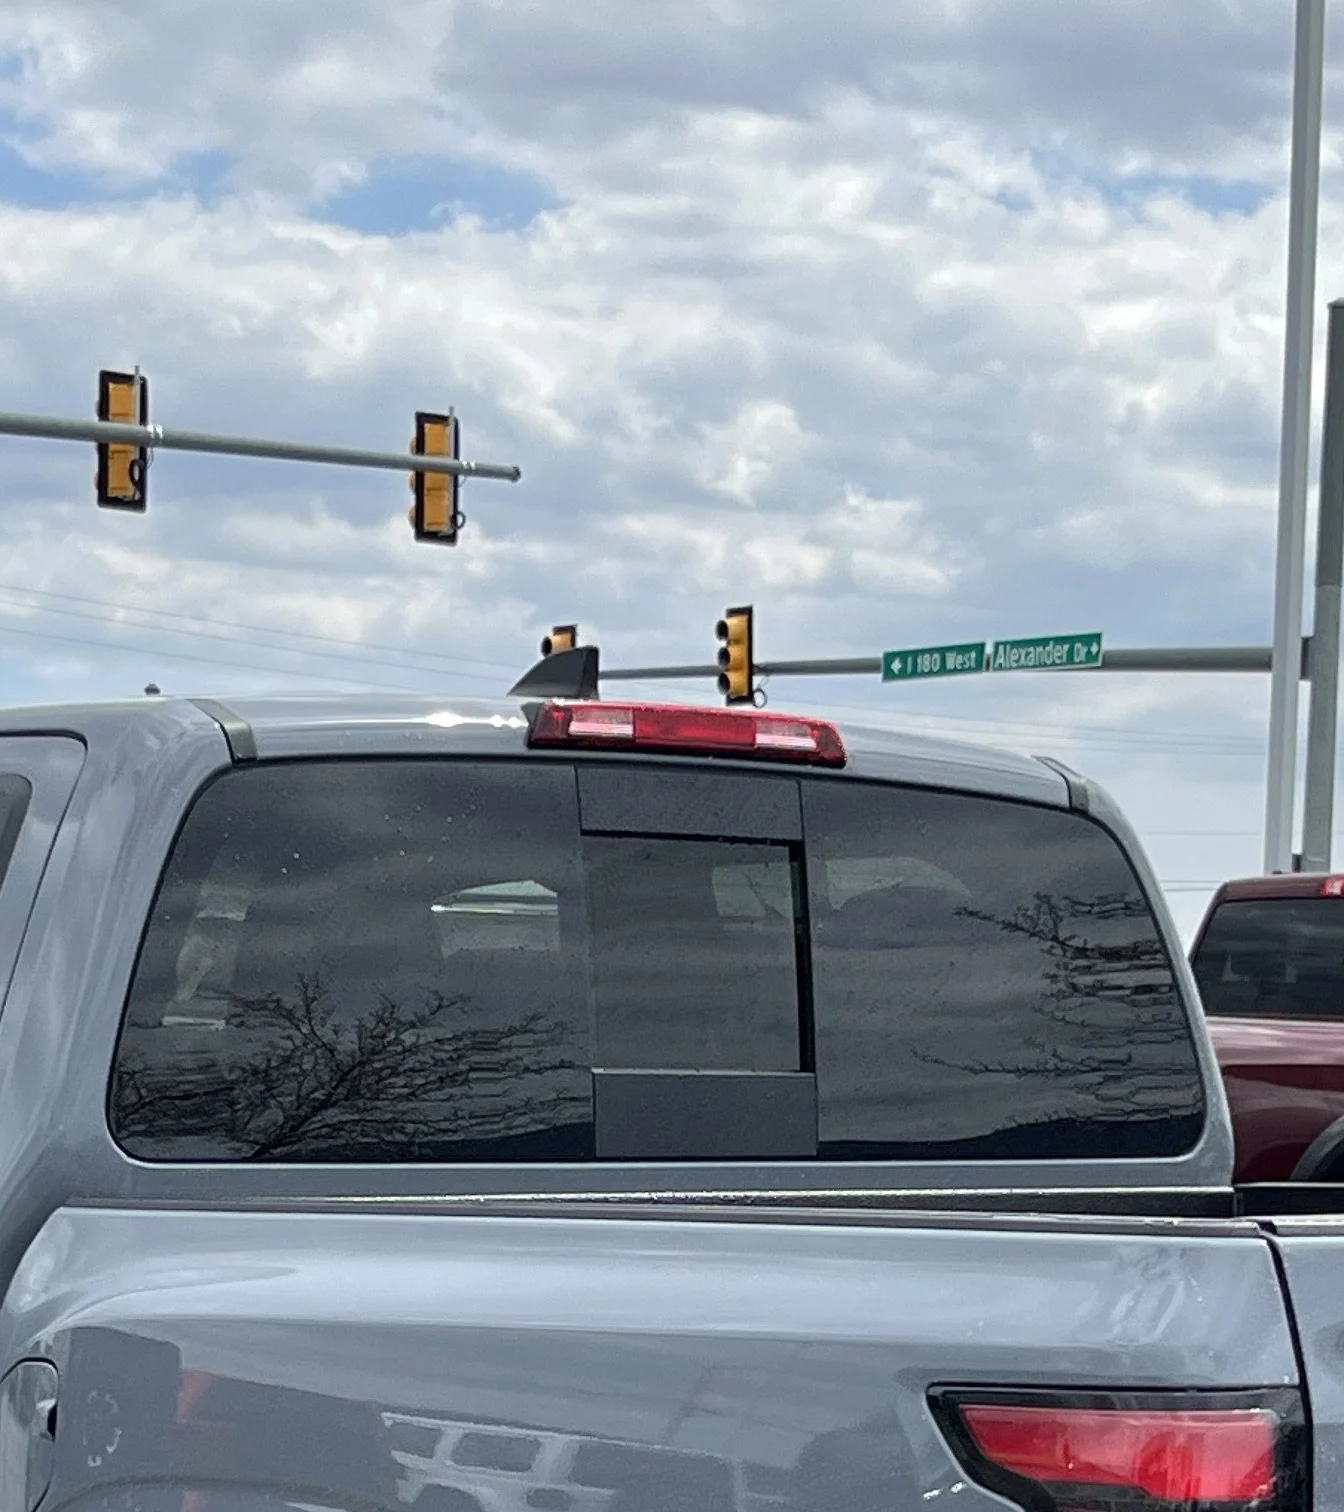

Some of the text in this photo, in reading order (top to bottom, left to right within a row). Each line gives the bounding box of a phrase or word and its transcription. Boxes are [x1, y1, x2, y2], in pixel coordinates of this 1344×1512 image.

[916, 653, 941, 673] 180
[945, 650, 976, 670] West
[994, 640, 1089, 669] Alexander Dr
